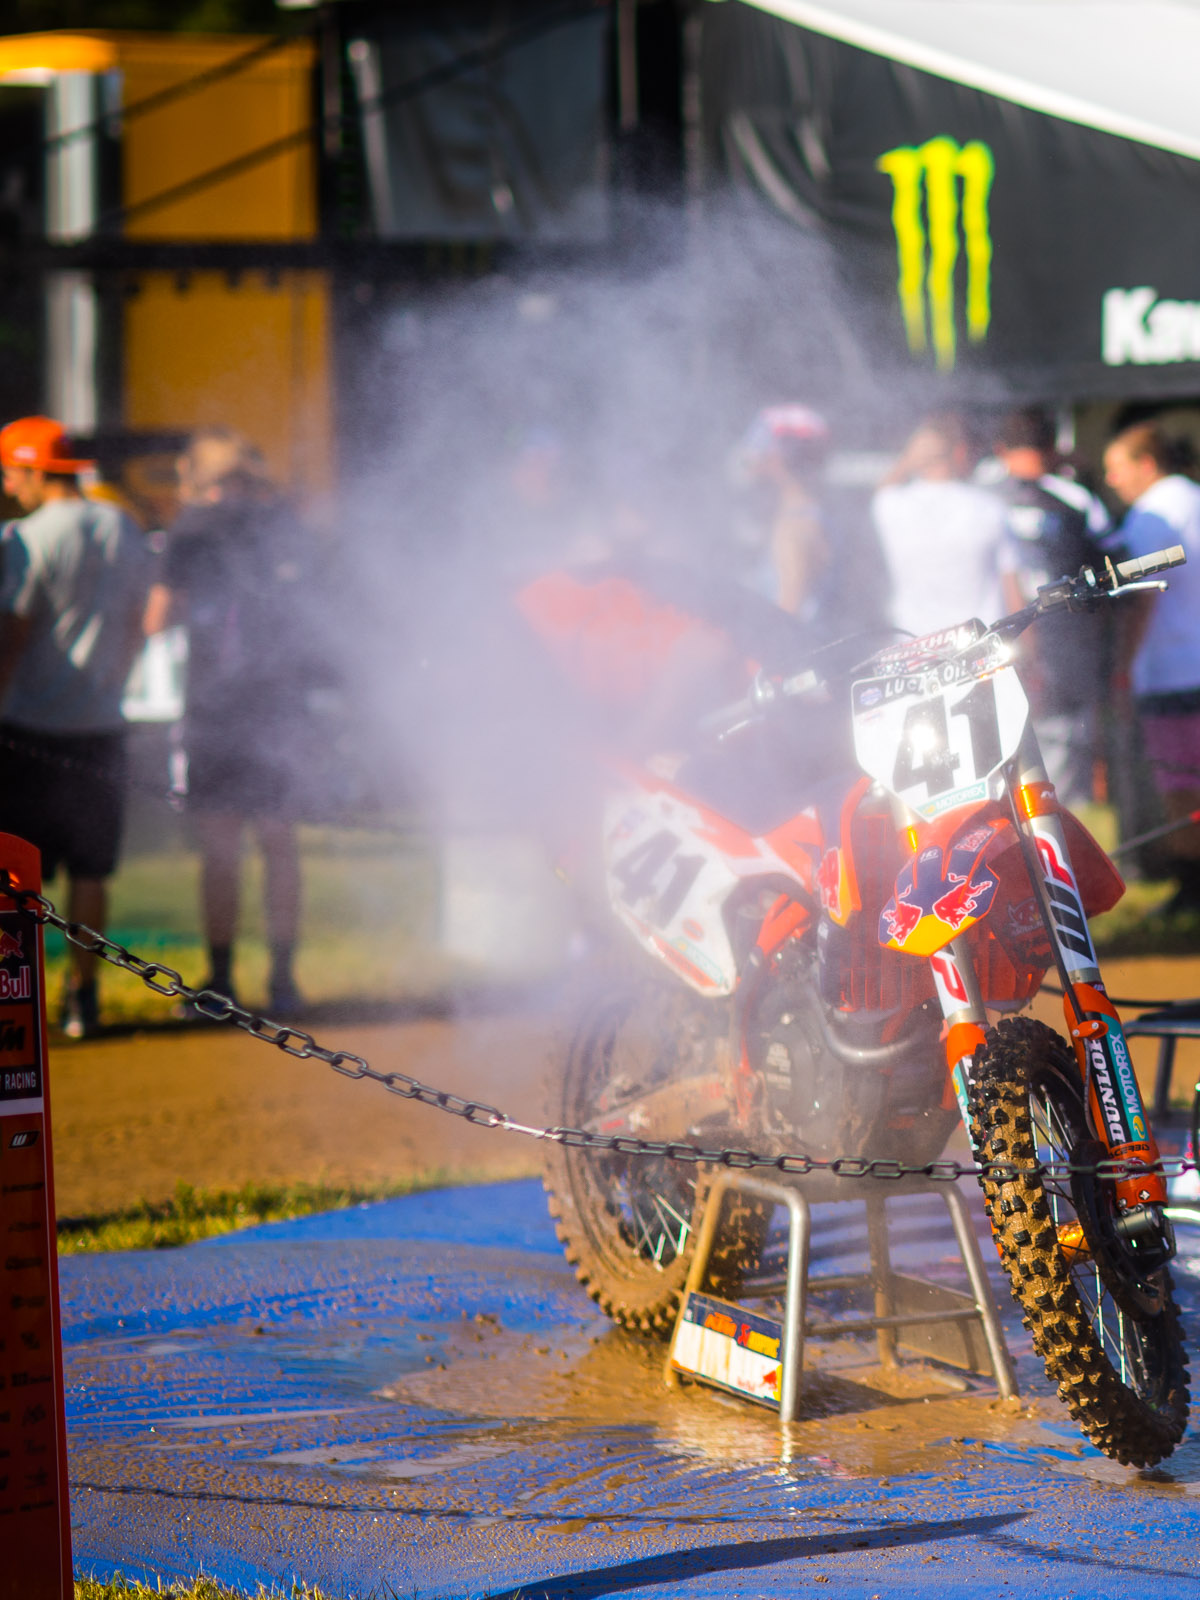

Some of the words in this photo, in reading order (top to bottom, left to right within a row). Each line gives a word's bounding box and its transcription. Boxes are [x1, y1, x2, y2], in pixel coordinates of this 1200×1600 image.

[885, 668, 938, 698] LUCA
[892, 677, 1004, 799] 41
[611, 829, 708, 932] 41
[5, 1071, 37, 1091] RACING
[1110, 1033, 1141, 1114] MOTOREX
